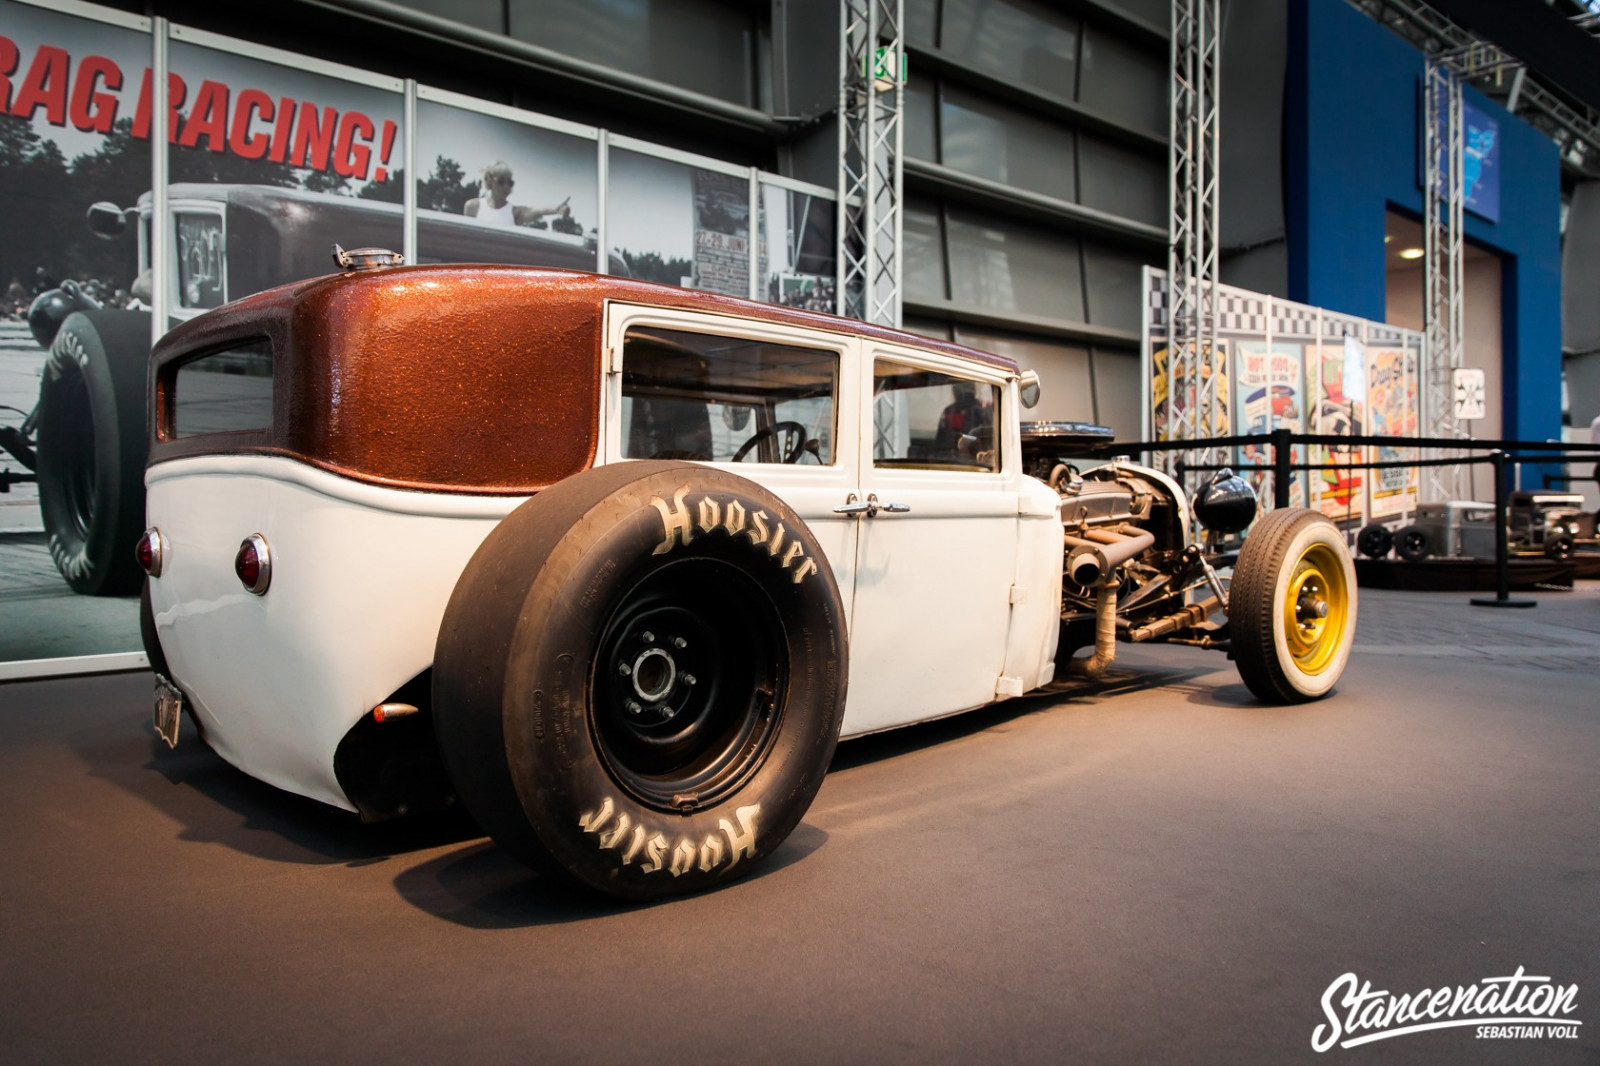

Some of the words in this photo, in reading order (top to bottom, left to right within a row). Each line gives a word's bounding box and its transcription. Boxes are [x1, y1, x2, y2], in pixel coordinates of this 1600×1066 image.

[130, 67, 397, 184] RACING!
[650, 483, 818, 584] Hoosier
[578, 796, 761, 879] Hoosier
